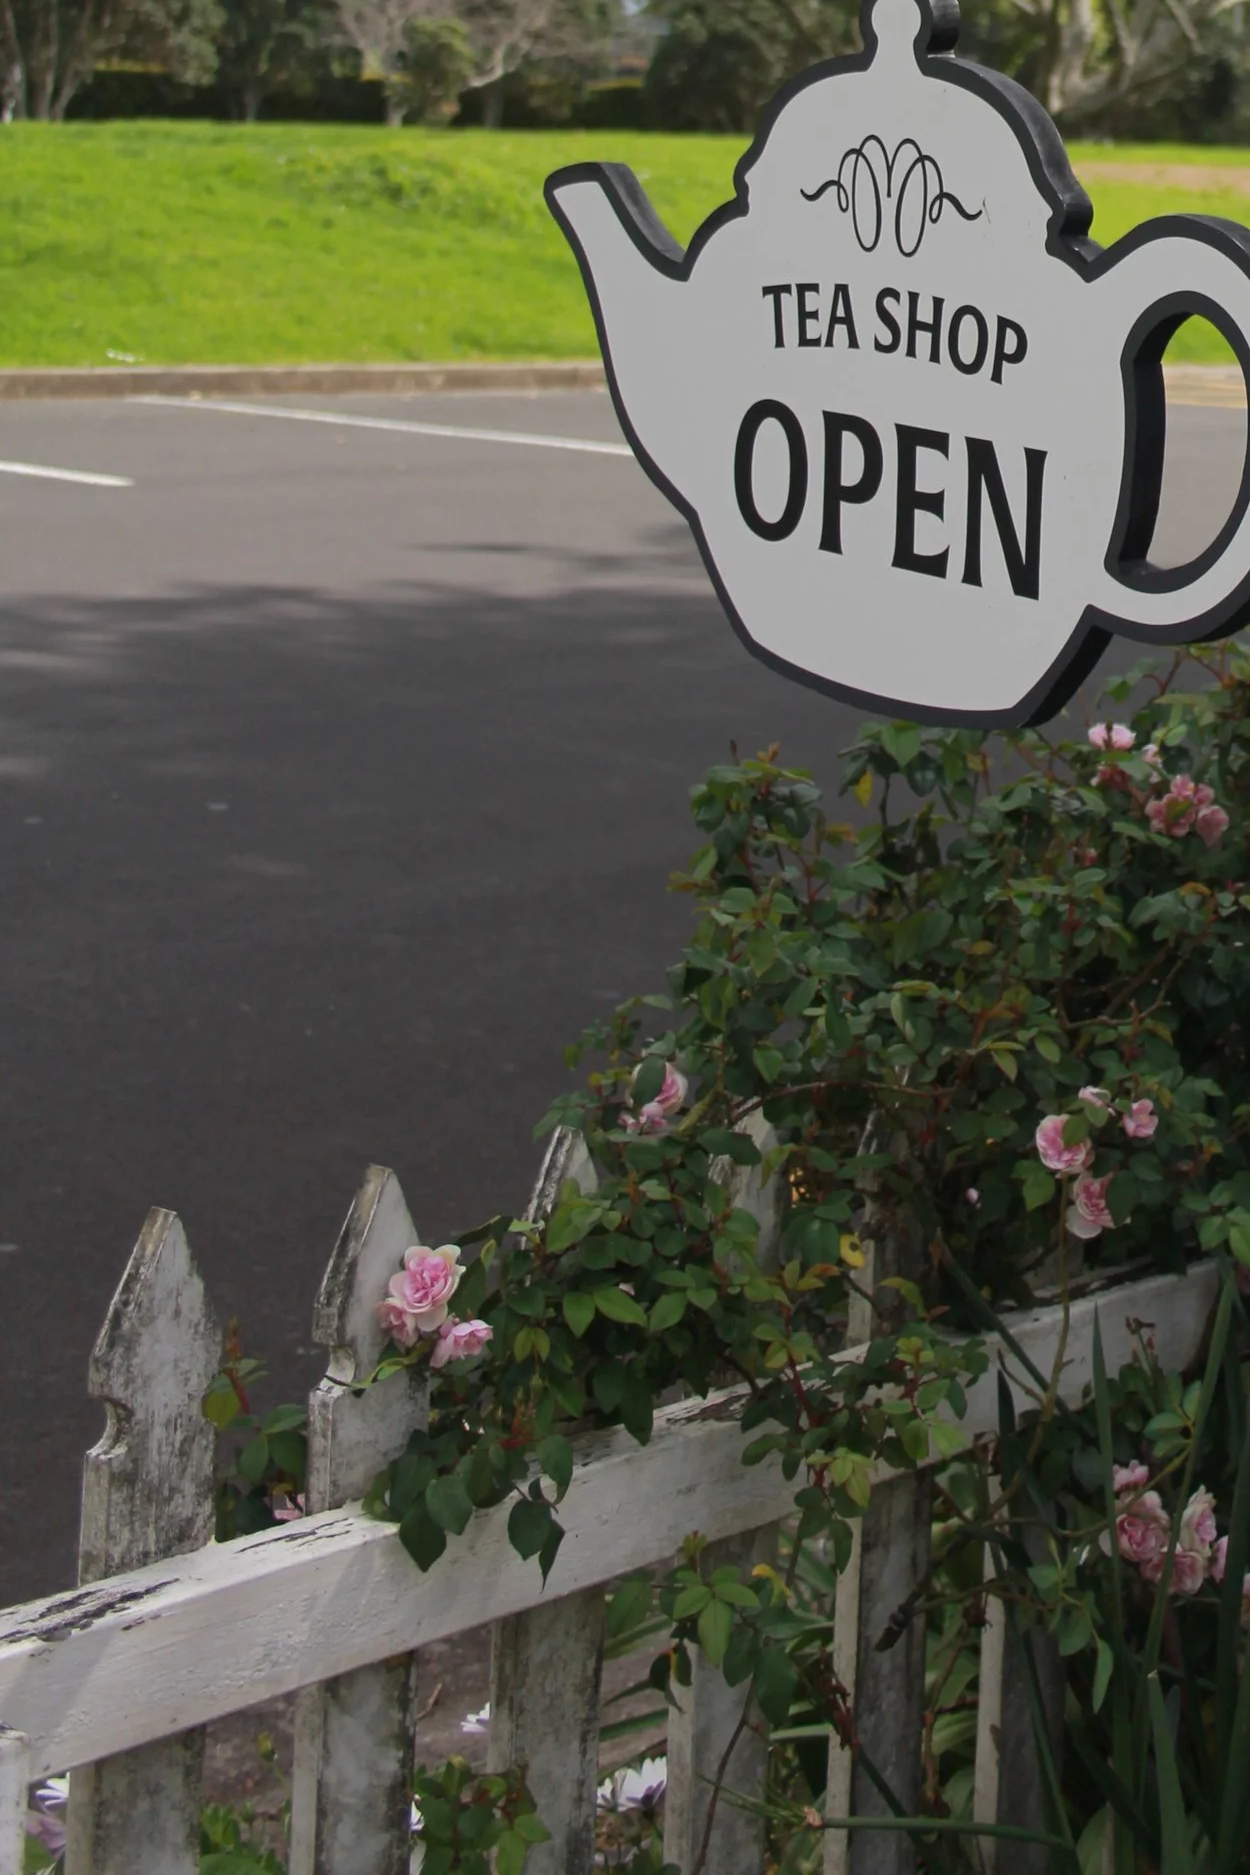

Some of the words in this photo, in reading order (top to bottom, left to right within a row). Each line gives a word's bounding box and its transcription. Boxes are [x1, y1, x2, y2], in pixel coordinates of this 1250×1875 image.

[761, 282, 860, 350] TEA
[873, 286, 1028, 386] SHOP
[733, 398, 1049, 601] OPEN
